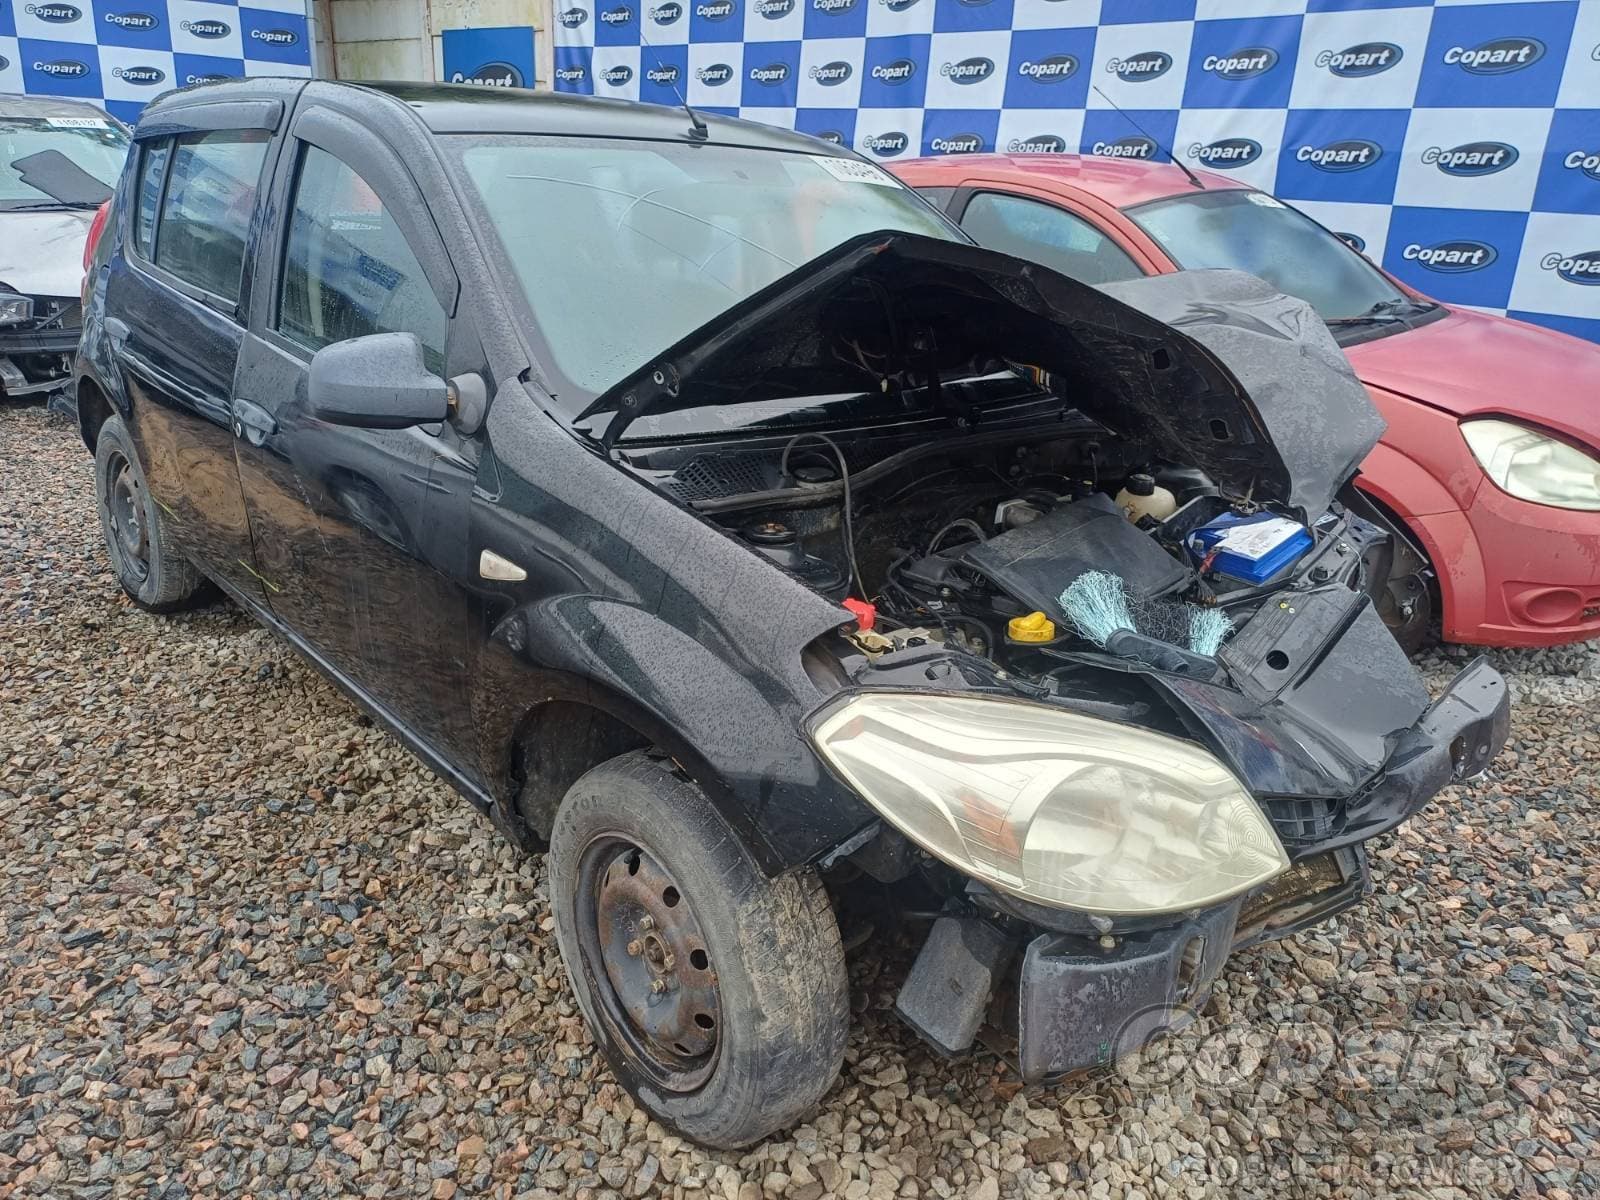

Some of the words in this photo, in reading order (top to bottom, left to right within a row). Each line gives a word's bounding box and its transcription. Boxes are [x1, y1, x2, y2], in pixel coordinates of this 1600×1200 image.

[25, 3, 73, 18] Copart
[695, 5, 730, 18] Copart
[754, 0, 789, 13] Copart
[105, 13, 151, 26] Copart
[601, 9, 629, 23] Copart
[649, 8, 677, 22] Copart
[180, 21, 223, 34] Copart
[251, 30, 292, 42] Copart
[1315, 49, 1389, 70] Copart
[1444, 44, 1531, 67] Copart
[34, 61, 82, 74] Copart
[940, 62, 987, 78] Copart
[1019, 60, 1070, 78] Copart
[1105, 57, 1162, 75] Copart
[1202, 54, 1268, 74] Copart
[112, 67, 157, 80] Copart
[556, 69, 583, 80] Copart
[600, 68, 627, 81] Copart
[647, 69, 676, 82] Copart
[695, 67, 727, 81] Copart
[750, 67, 785, 82] Copart
[808, 65, 845, 80] Copart
[872, 64, 909, 80] Copart
[864, 135, 903, 150] Copart
[931, 138, 977, 153] Copart
[1007, 138, 1057, 152] Copart
[1093, 141, 1149, 157] Copart
[1187, 142, 1251, 161] Copart
[1297, 145, 1371, 164] Copart
[1421, 146, 1504, 168] Copart
[1403, 243, 1485, 266] Copart
[1540, 252, 1600, 275] Copa
